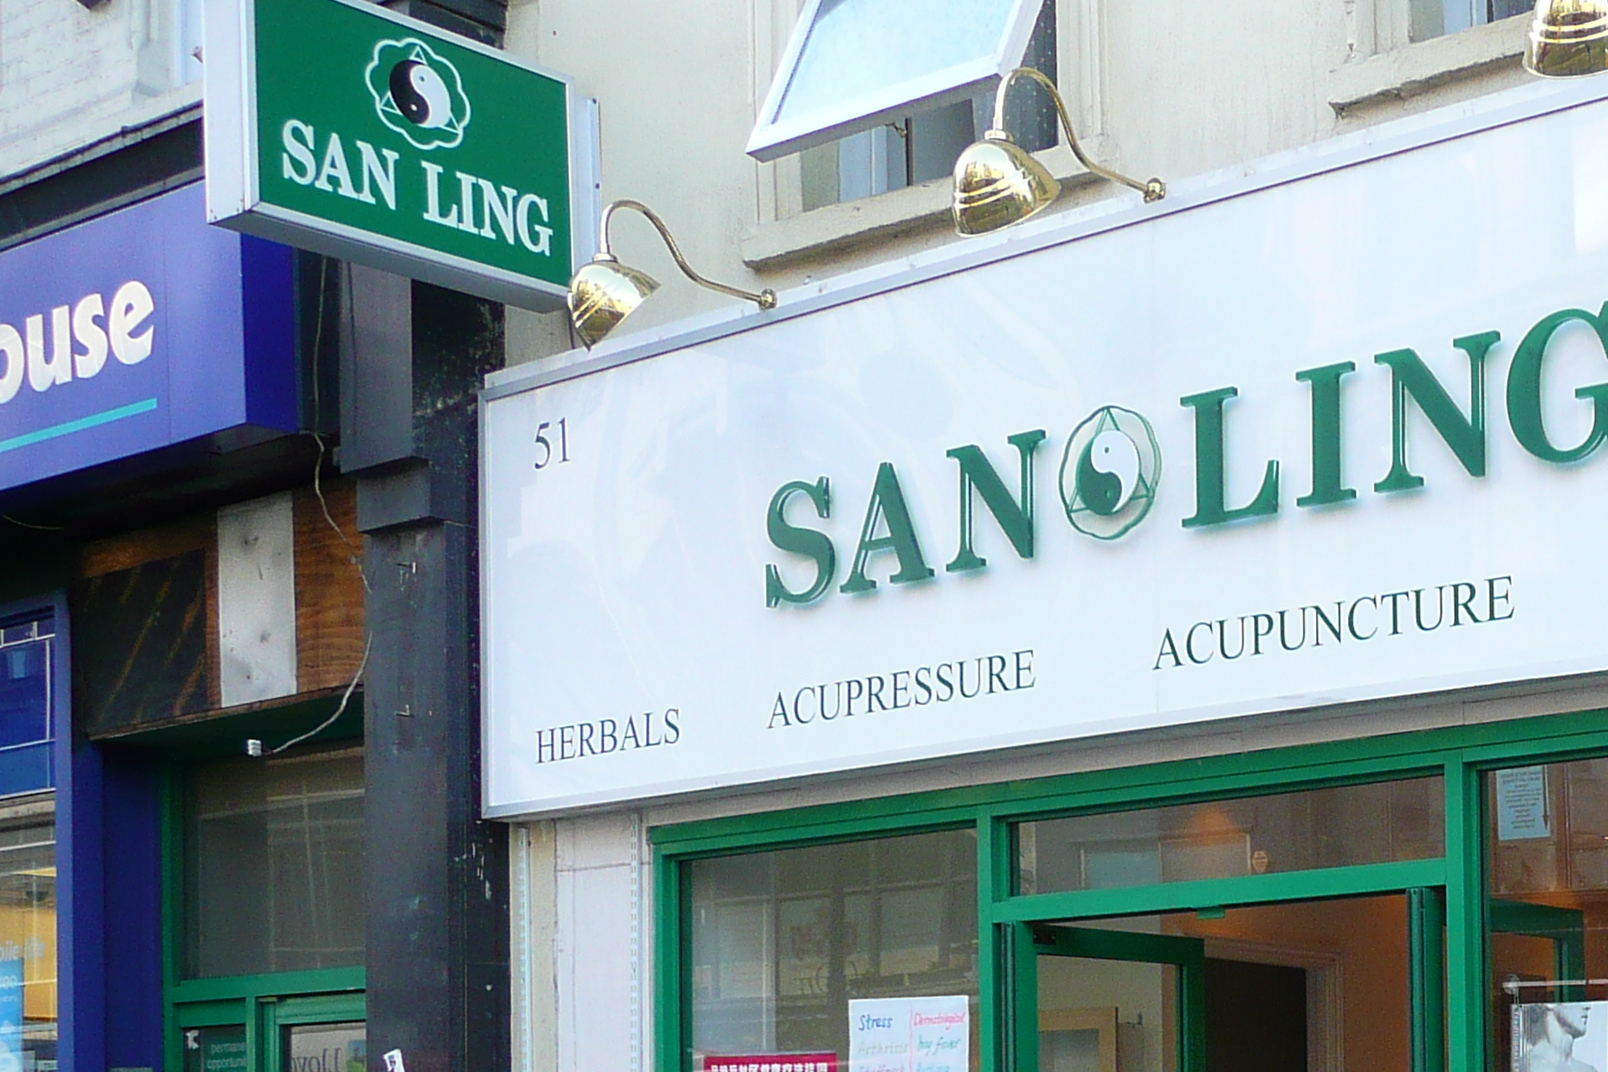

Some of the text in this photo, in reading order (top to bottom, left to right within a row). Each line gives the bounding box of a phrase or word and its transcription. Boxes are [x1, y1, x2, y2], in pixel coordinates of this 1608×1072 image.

[281, 120, 553, 257] SAN LING
[533, 417, 571, 469] 51
[765, 429, 1046, 608] SAN
[1152, 576, 1515, 671] ACUPUNCTURE
[766, 650, 1036, 730] ACUPRESSURE
[536, 708, 681, 766] HERBALS
[859, 1014, 893, 1031] Stress
